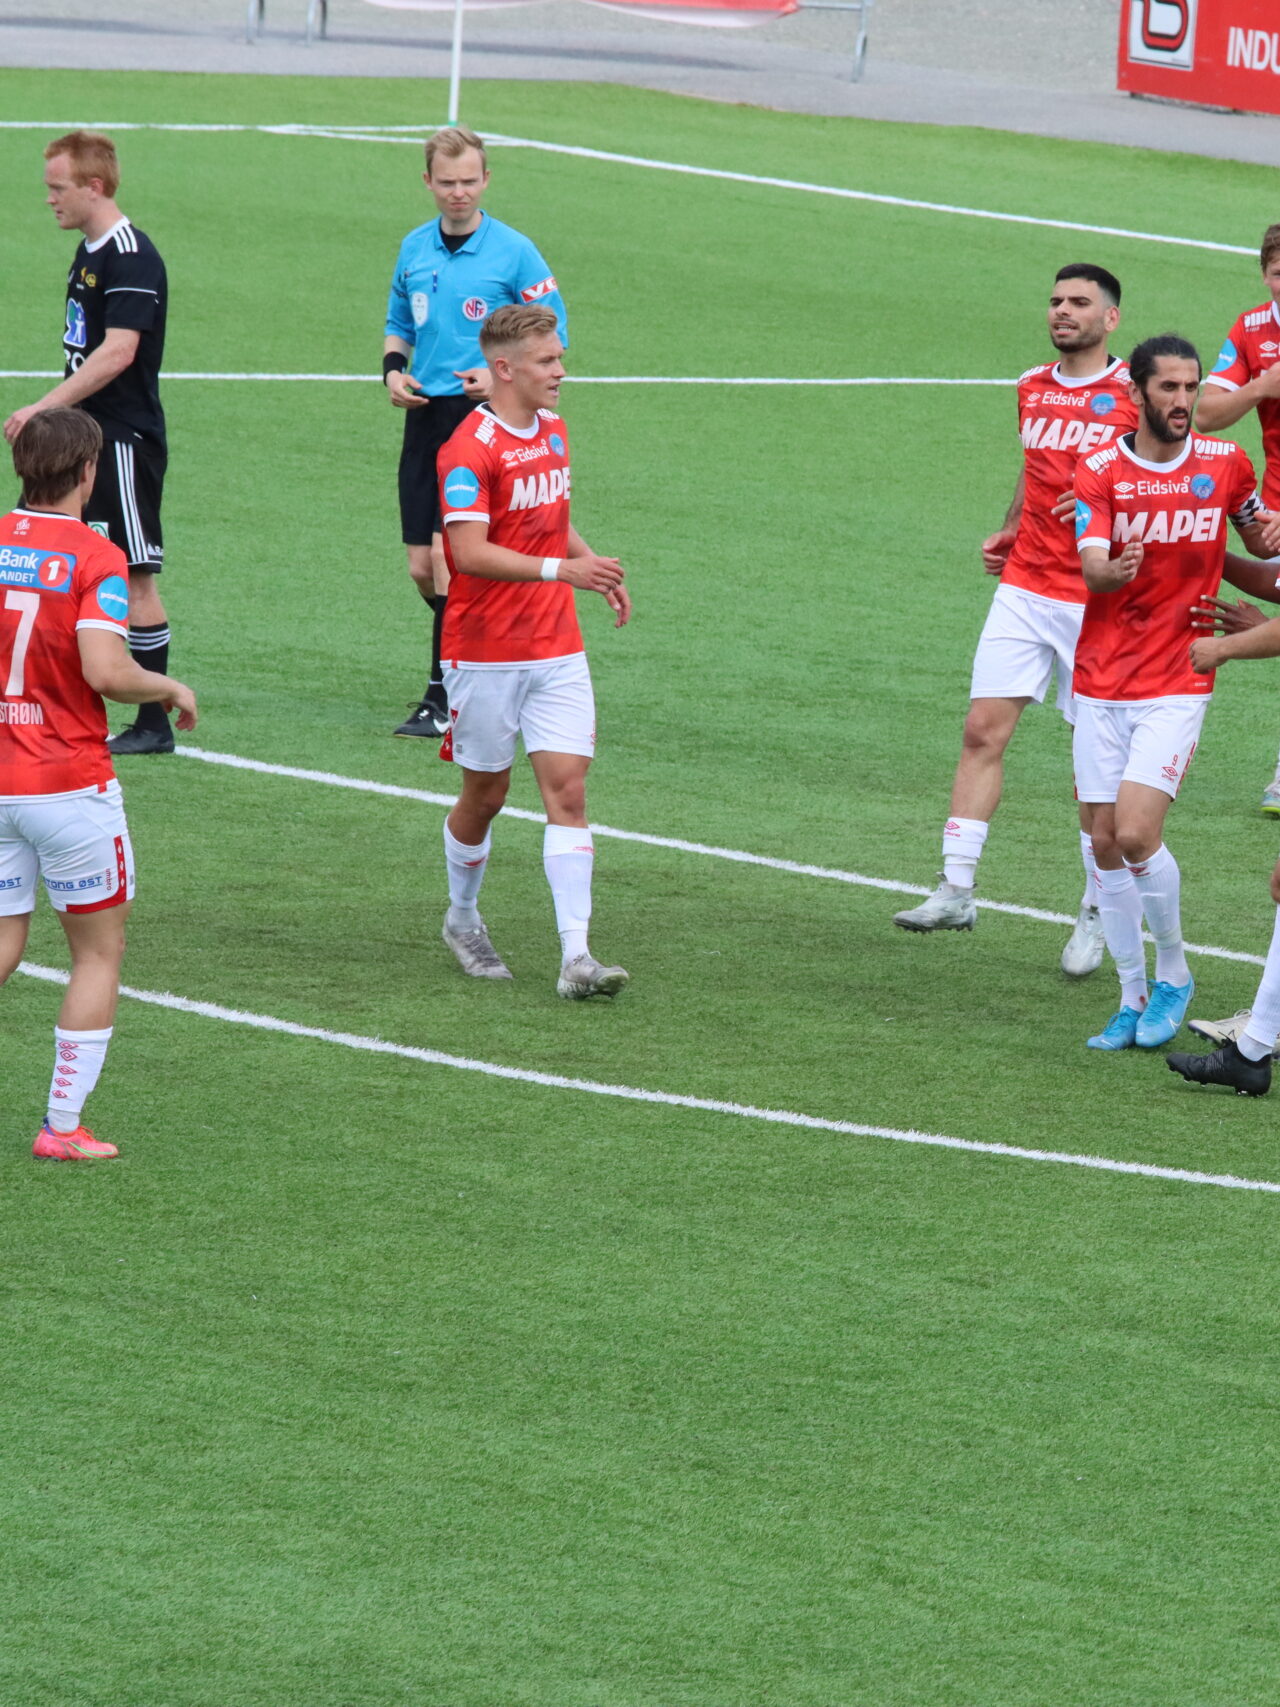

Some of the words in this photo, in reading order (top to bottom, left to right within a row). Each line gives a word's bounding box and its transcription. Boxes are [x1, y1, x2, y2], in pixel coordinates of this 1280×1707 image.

[1021, 417, 1116, 454] MAPEI
[1137, 479, 1190, 496] Eidsiva
[1111, 507, 1223, 544] MAPEI
[0, 548, 40, 570] Bank
[47, 560, 61, 582] 1
[4, 589, 41, 697] 7
